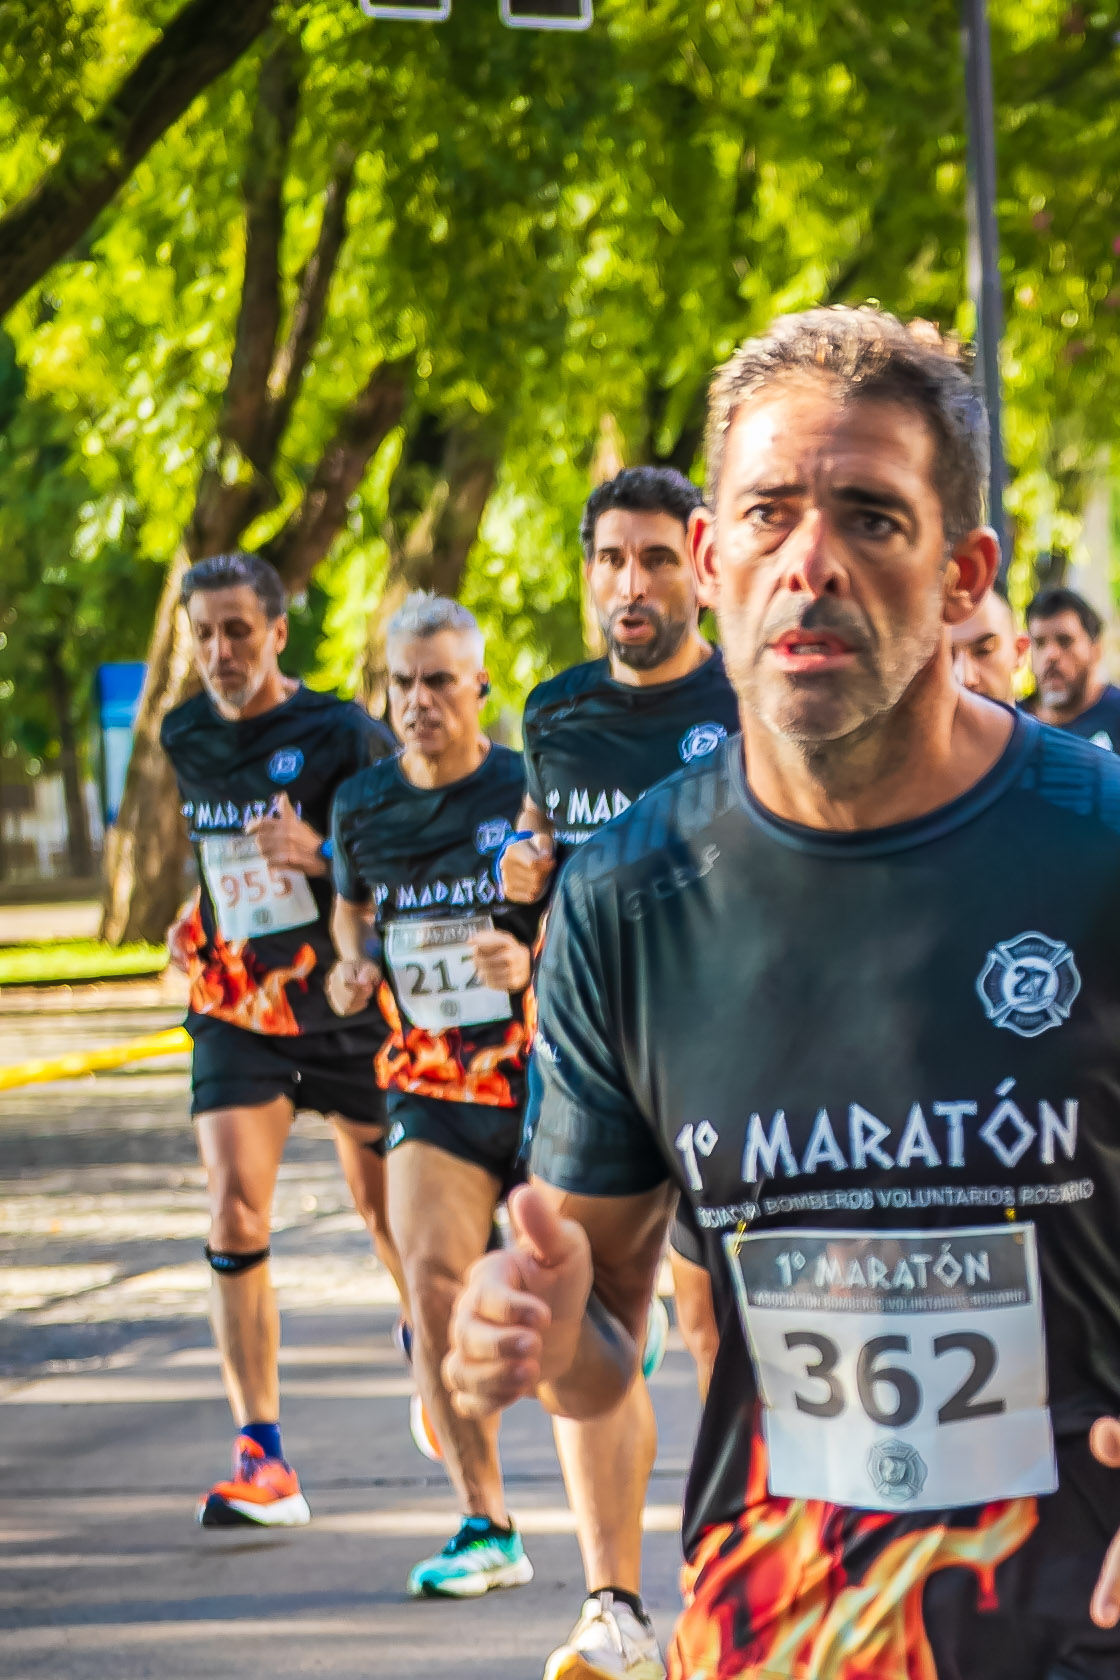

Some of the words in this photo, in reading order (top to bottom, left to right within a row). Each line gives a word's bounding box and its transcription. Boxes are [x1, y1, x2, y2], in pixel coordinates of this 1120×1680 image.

[220, 867, 293, 909] 955
[740, 1076, 1079, 1184] MARATÓN
[875, 1184, 1015, 1209] VOLUNTARIOS
[1021, 1177, 1095, 1206] ROSARIO
[814, 1242, 990, 1290] MARATÓN
[784, 1330, 1007, 1429] 362
